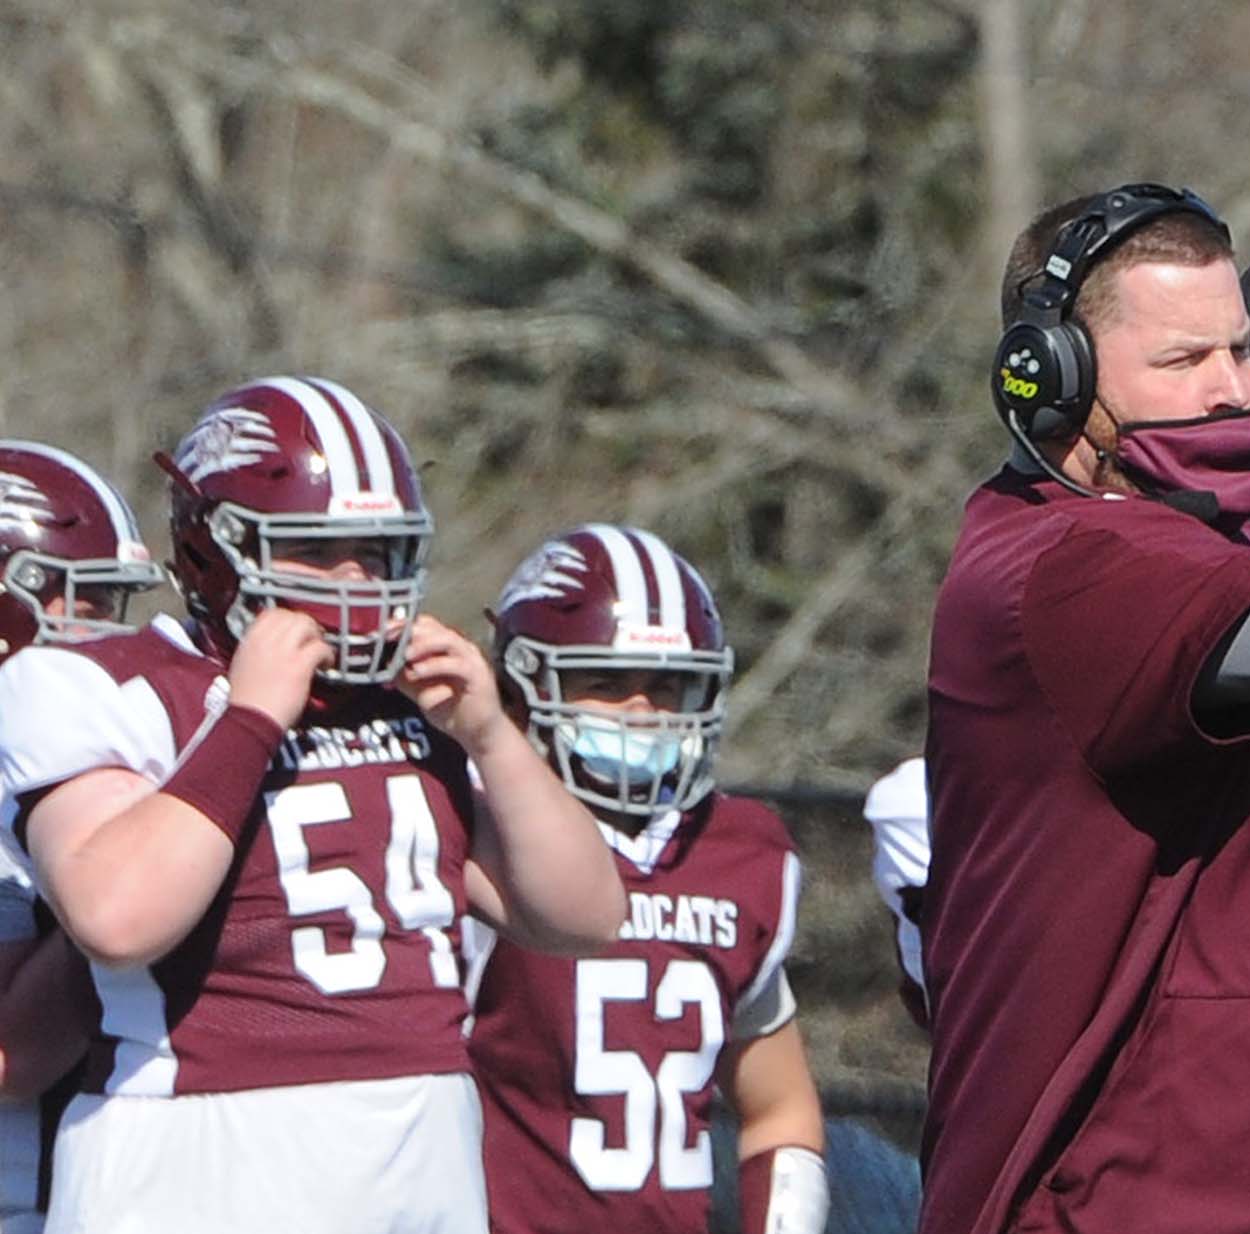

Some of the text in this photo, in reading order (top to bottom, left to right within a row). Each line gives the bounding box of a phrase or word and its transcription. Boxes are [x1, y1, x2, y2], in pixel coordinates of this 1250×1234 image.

[266, 718, 431, 771] ILDCATS
[264, 773, 459, 993] 54
[618, 891, 738, 948] DCATS
[569, 959, 724, 1192] 52
